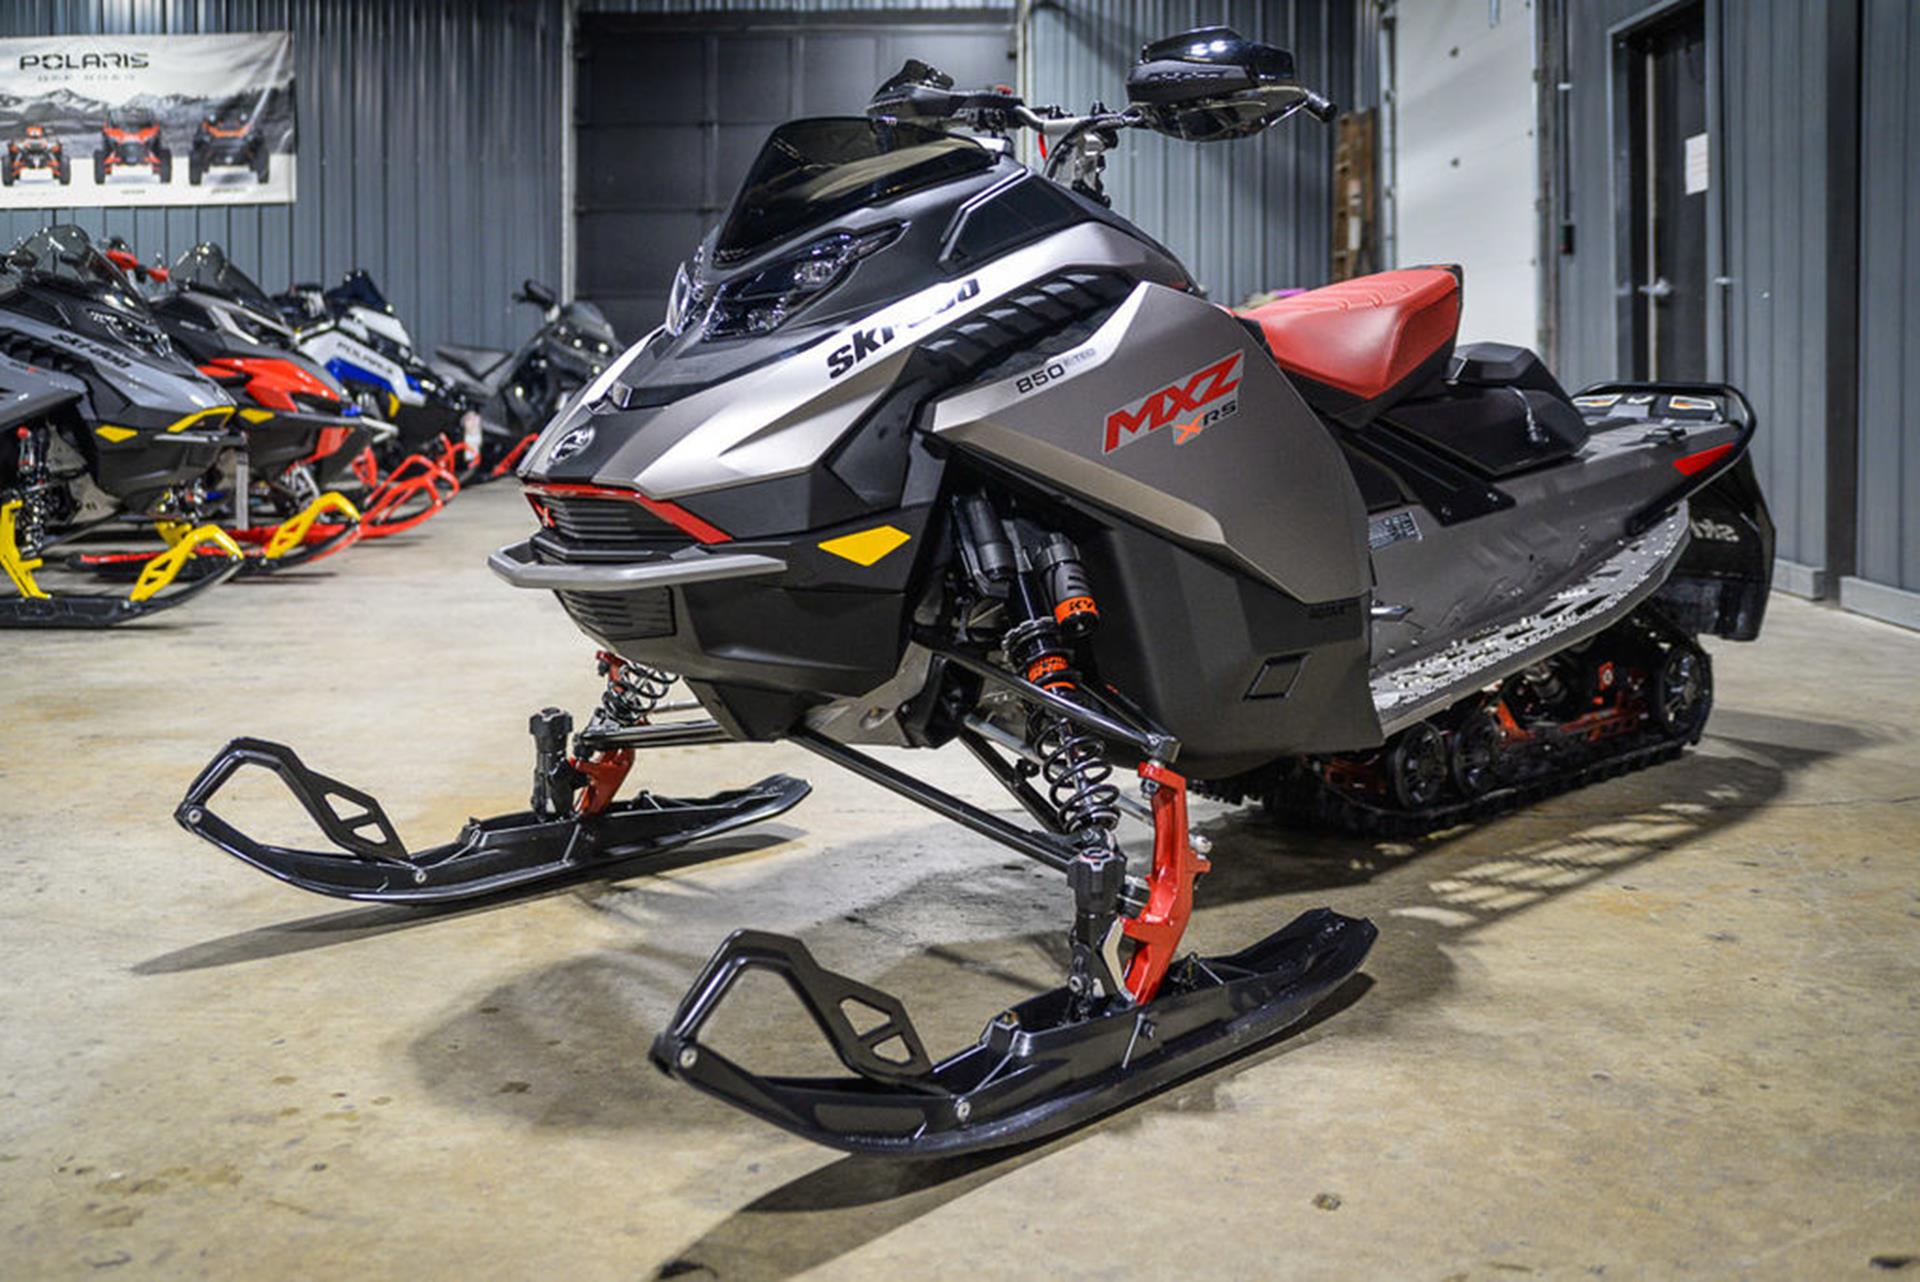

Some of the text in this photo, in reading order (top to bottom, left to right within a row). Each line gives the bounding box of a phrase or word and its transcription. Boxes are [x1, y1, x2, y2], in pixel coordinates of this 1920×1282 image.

[19, 53, 150, 71] POLARIS
[827, 278, 981, 380] skio
[1016, 363, 1065, 394] 850
[1104, 351, 1243, 453] MXZ
